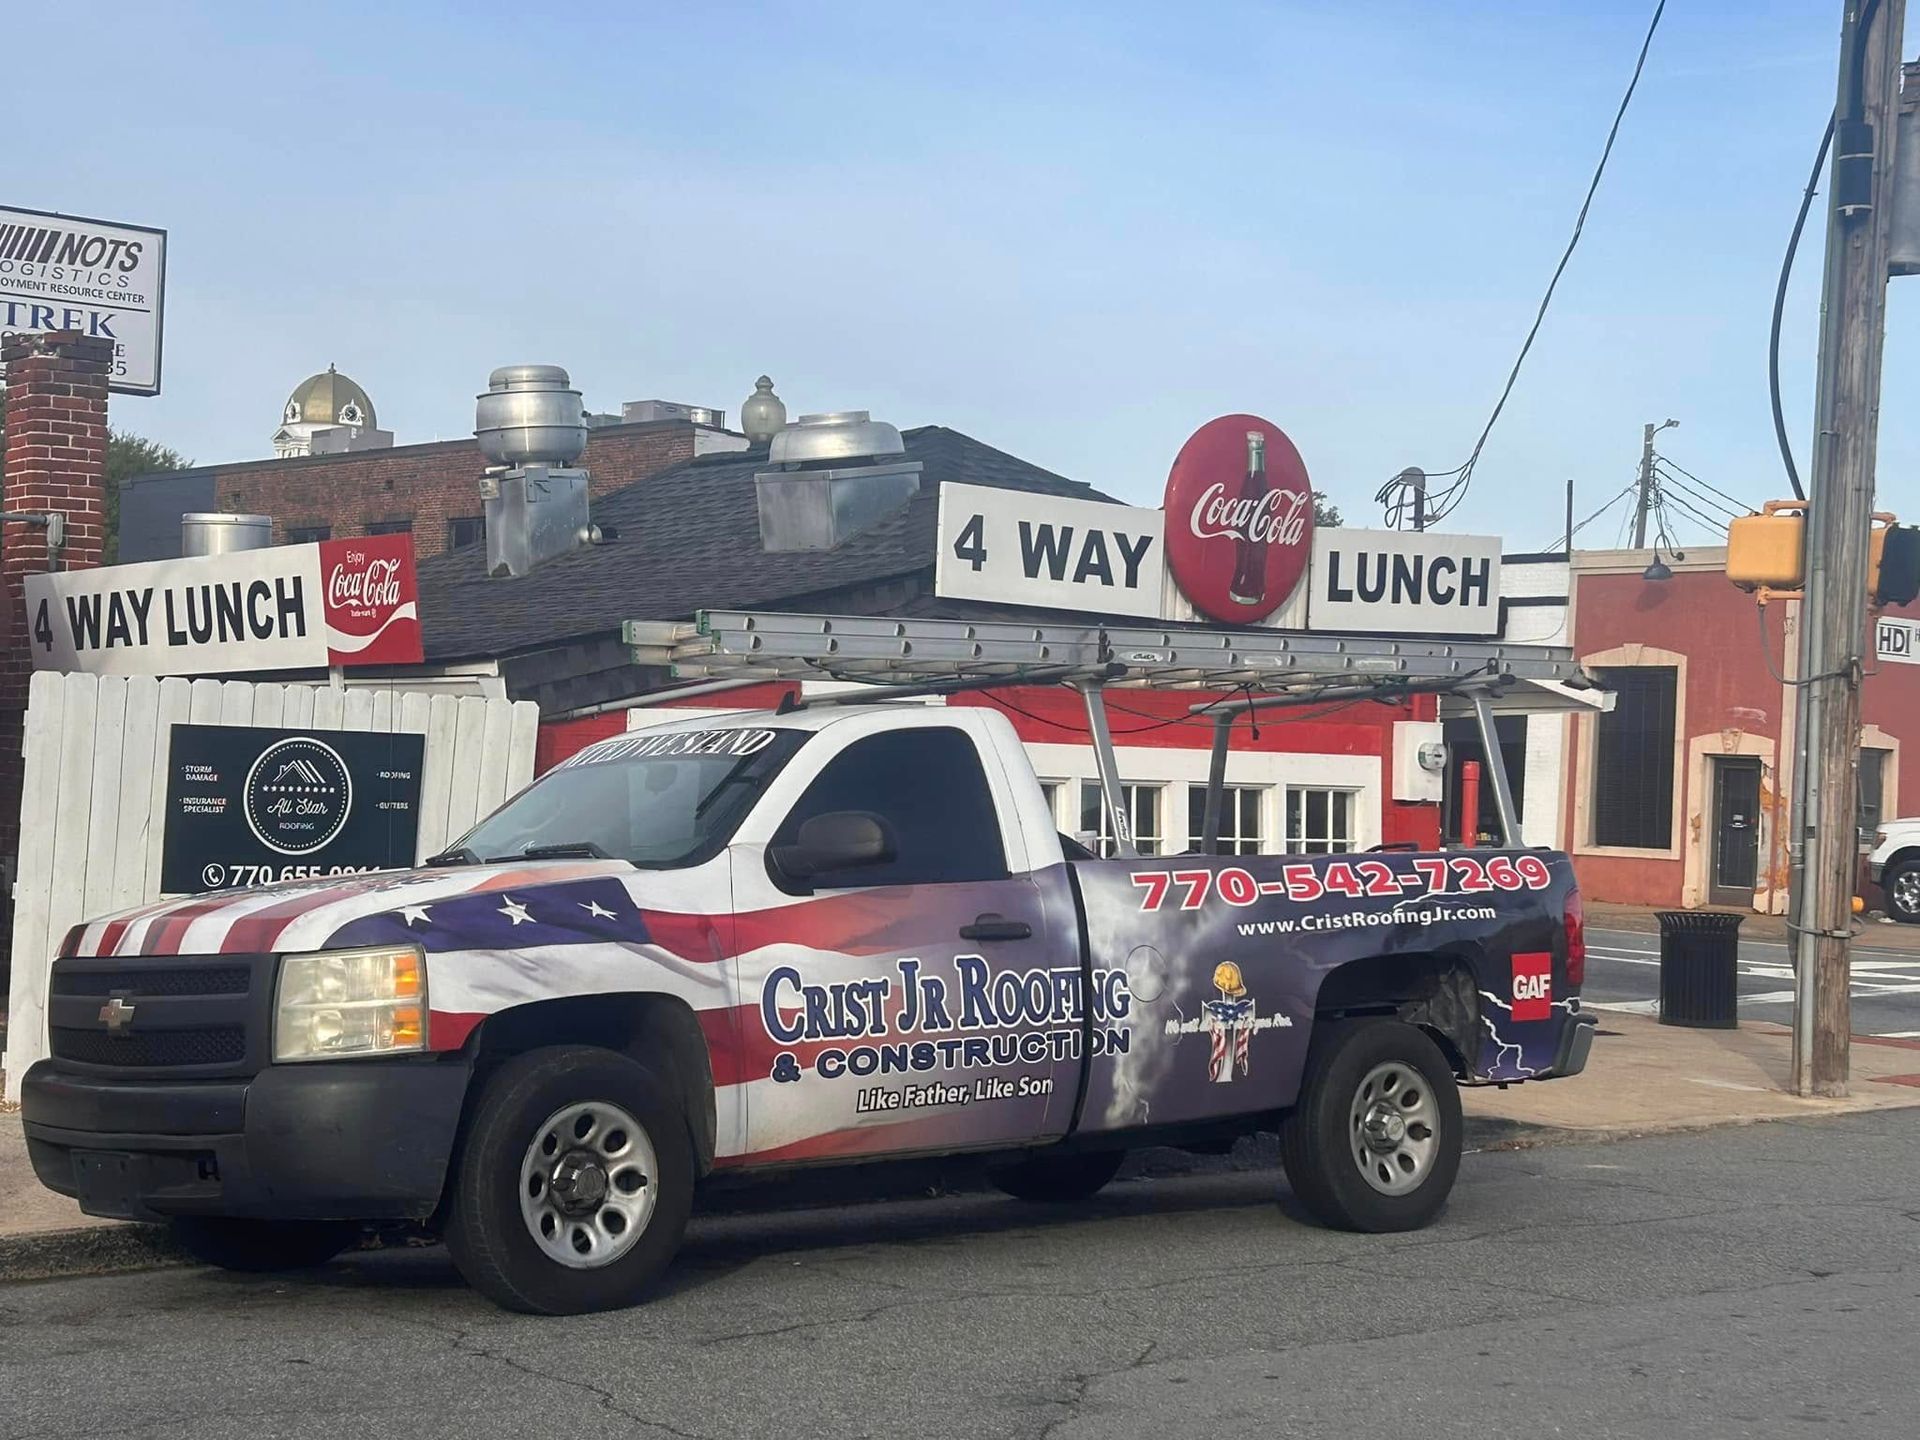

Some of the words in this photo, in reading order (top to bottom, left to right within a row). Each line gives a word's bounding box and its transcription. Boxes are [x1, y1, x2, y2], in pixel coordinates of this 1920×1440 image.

[54, 233, 143, 272] NOTS
[0, 260, 130, 288] OGISTICS
[0, 277, 47, 292] OYMENT
[50, 283, 104, 299] RESOURCE
[106, 290, 145, 304] CENTER
[1190, 482, 1309, 546] Coca-Cola
[346, 550, 365, 566] Enjoy
[953, 513, 988, 571] 4
[1018, 520, 1153, 588] WAY
[328, 558, 401, 608] Coca-Cola
[1326, 550, 1491, 607] LUNCH
[35, 598, 53, 652] 4
[66, 587, 154, 651] WAY
[165, 576, 307, 647] LUNCH
[1879, 626, 1911, 654] HDI
[669, 729, 776, 756] STAND
[185, 764, 213, 773] STORM
[185, 773, 218, 782] DAMAGE
[183, 797, 227, 806] INSURANCE
[183, 805, 225, 814] SPECIALIST
[266, 797, 293, 818] All
[295, 798, 329, 815] Star
[379, 801, 409, 810] GUTTERS
[279, 822, 315, 830] ROOFING
[229, 865, 273, 888] 770
[1130, 855, 1552, 912] 770-542-7269
[1237, 904, 1497, 937] www.CristRoofingJr.com
[1512, 973, 1551, 1000] GAF
[770, 1051, 801, 1084] &
[815, 1026, 1131, 1080] CONSTRUCTION
[856, 1086, 900, 1113] Like
[902, 1080, 971, 1109] Father,
[974, 1076, 1013, 1101] Like
[1017, 1074, 1054, 1097] Son
